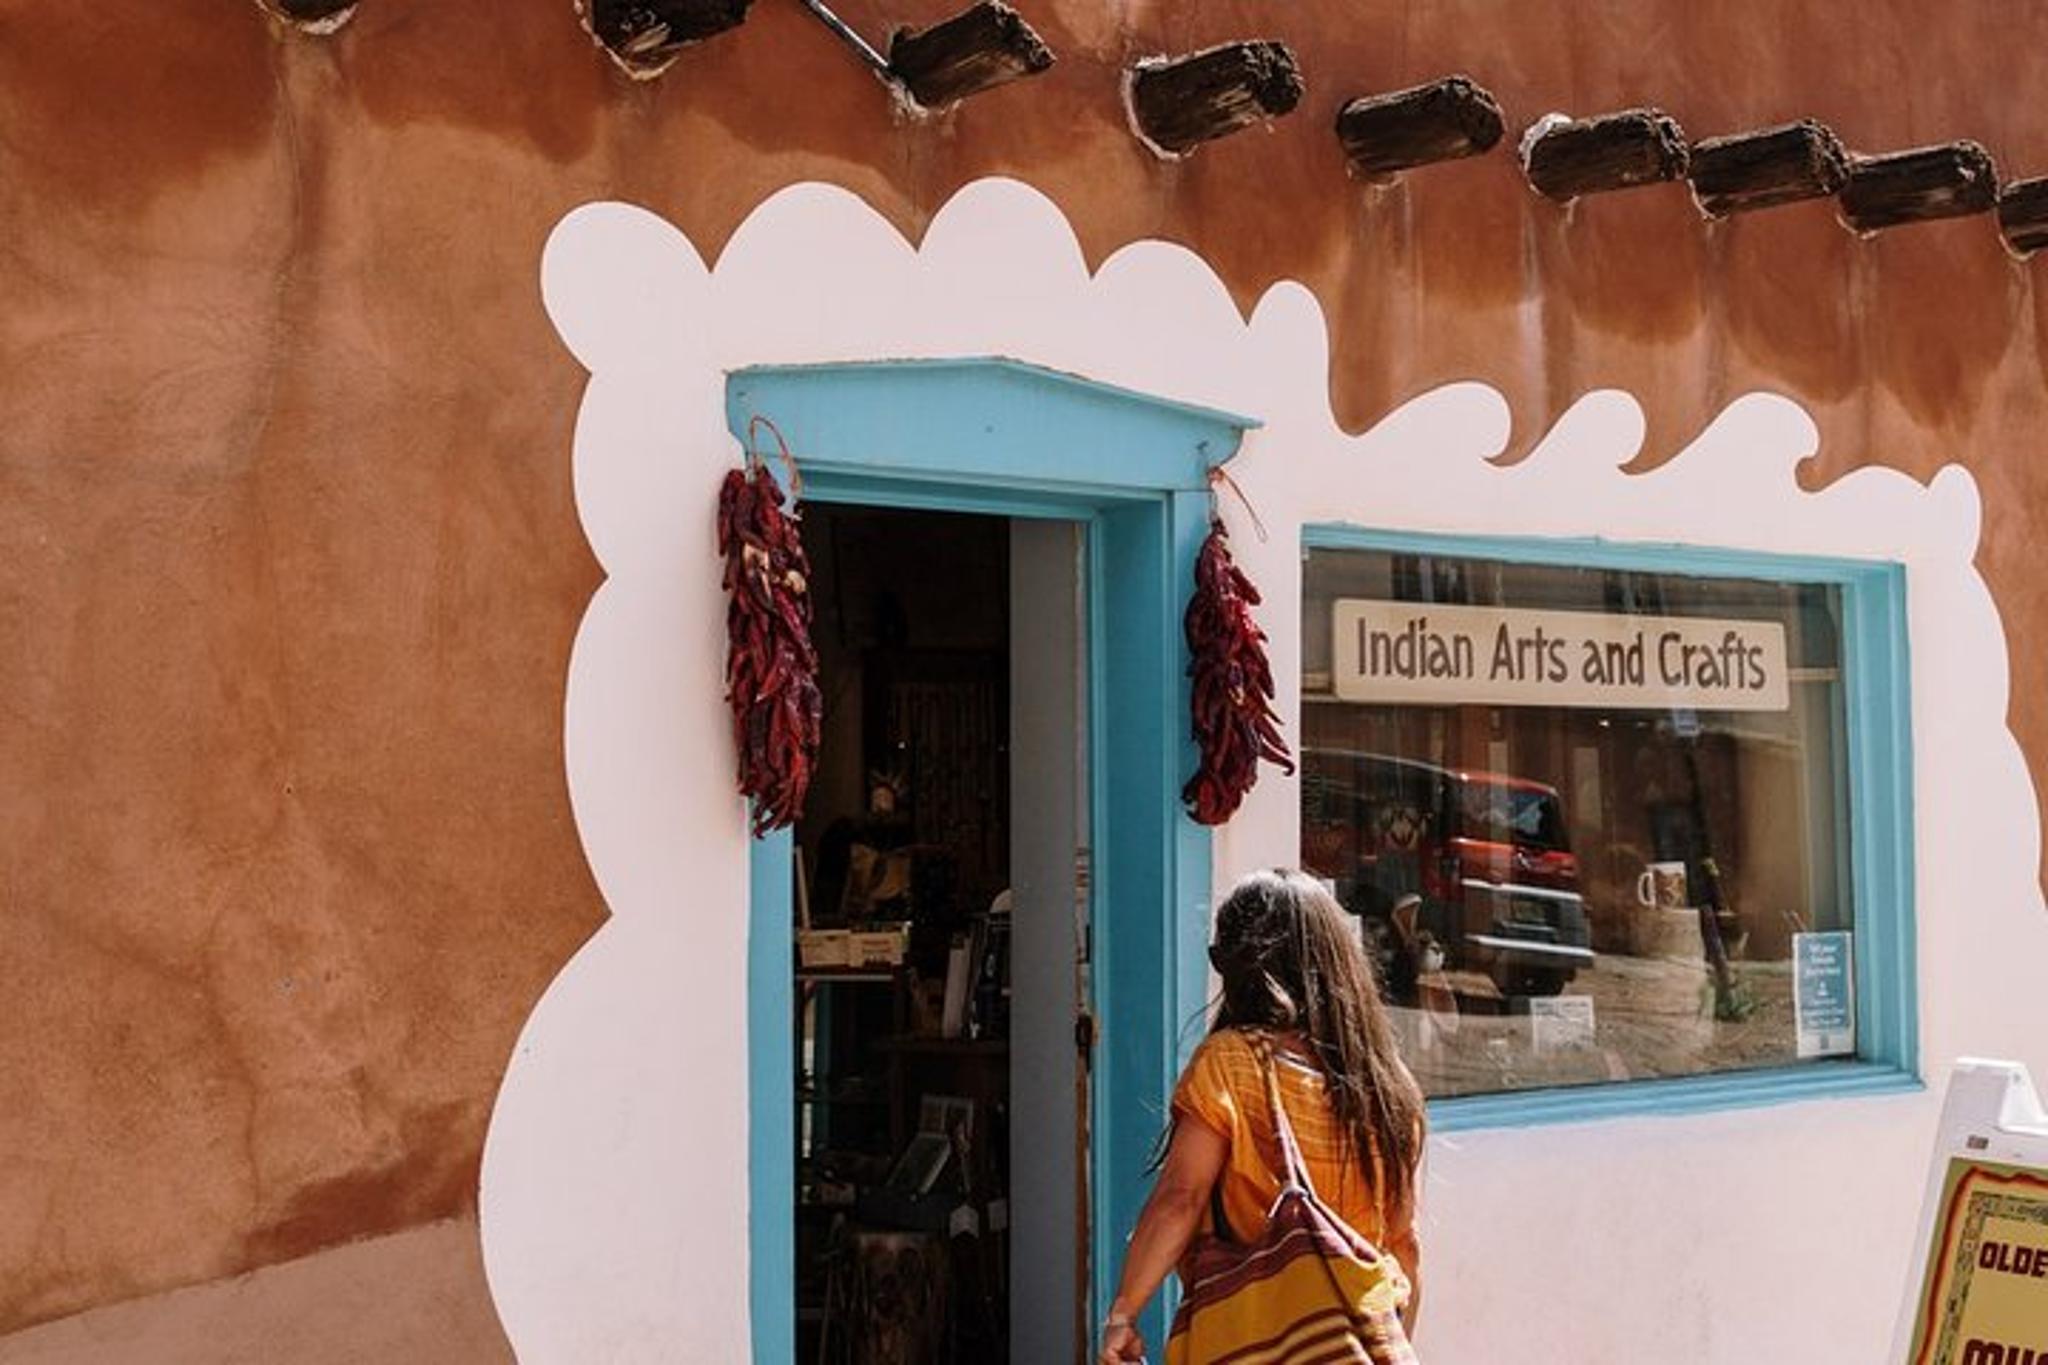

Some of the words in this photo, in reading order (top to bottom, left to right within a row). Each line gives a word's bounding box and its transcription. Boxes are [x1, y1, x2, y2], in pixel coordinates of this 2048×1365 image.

[1357, 615, 1474, 680] Indian
[1489, 621, 1569, 684] Arts
[1581, 631, 1645, 687] and
[1657, 630, 1767, 691] Crafts
